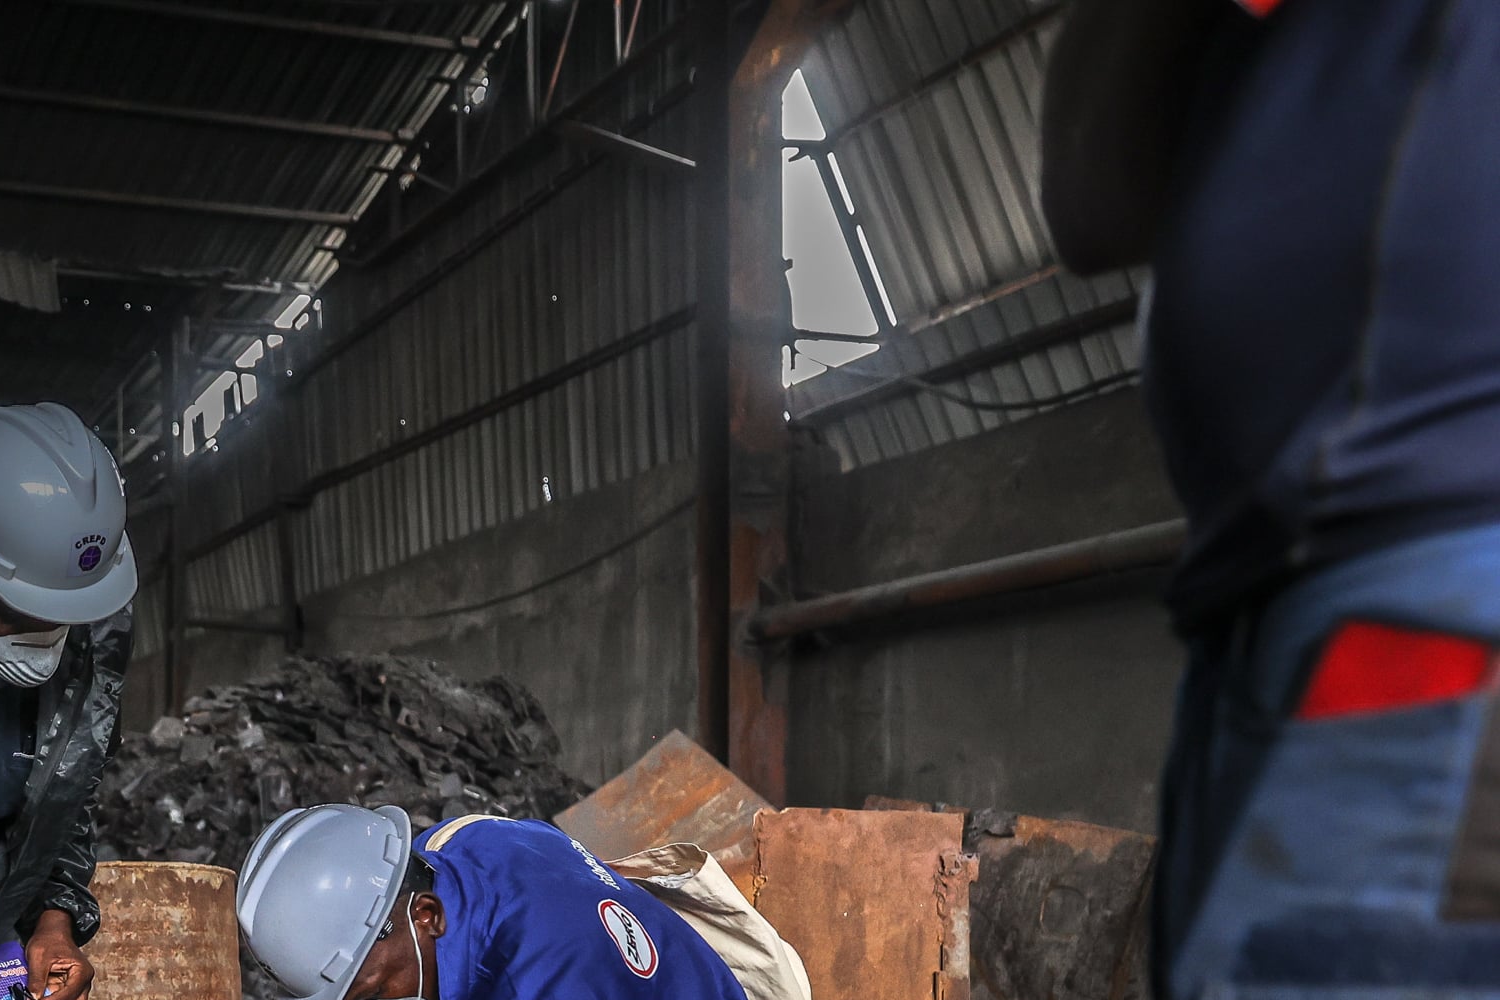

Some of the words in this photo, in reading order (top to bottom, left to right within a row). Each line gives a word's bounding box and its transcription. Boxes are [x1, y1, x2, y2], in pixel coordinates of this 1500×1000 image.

[75, 535, 106, 549] CREPD
[621, 913, 639, 964] ZERO
[0, 966, 28, 977] Bloc
